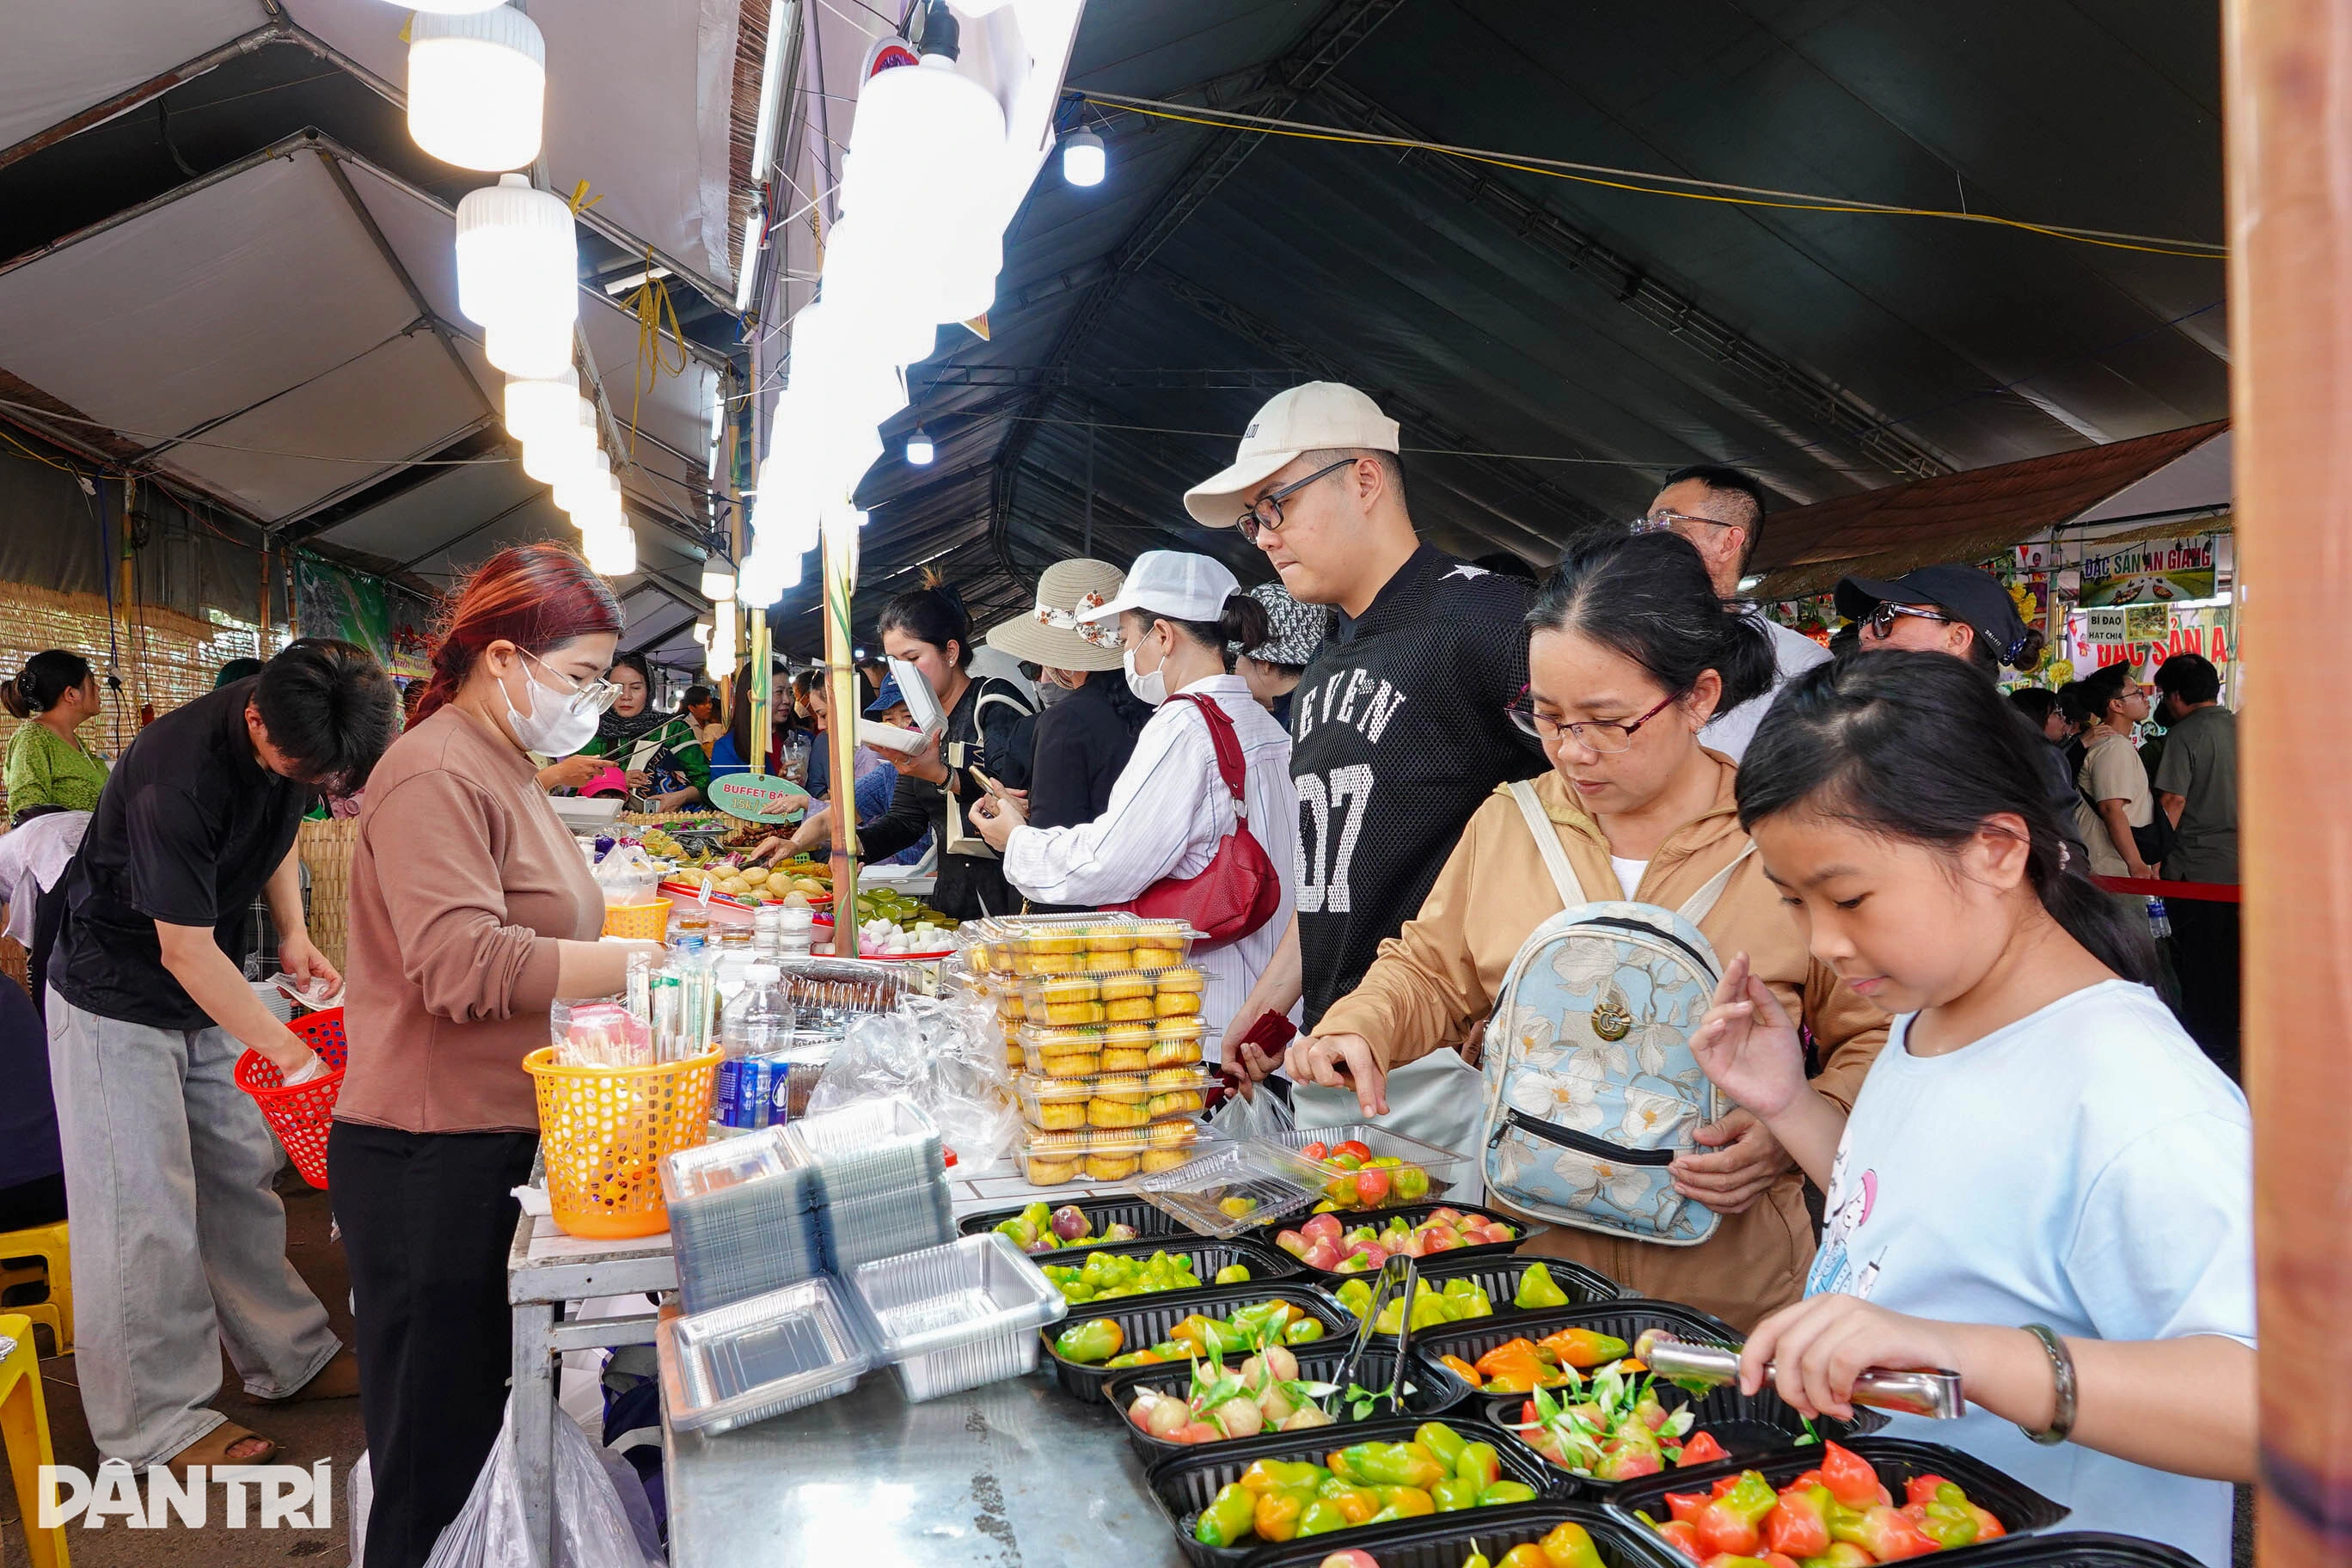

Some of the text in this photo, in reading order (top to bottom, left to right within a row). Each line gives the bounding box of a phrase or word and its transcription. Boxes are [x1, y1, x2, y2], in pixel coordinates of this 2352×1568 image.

[2144, 551, 2164, 572] AN
[2167, 548, 2210, 570] GIANG
[2091, 615, 2122, 625] BÍ ĐAO
[1290, 668, 1406, 744] EVEN
[723, 783, 767, 799] BUFFET
[1294, 763, 1374, 913] 07
